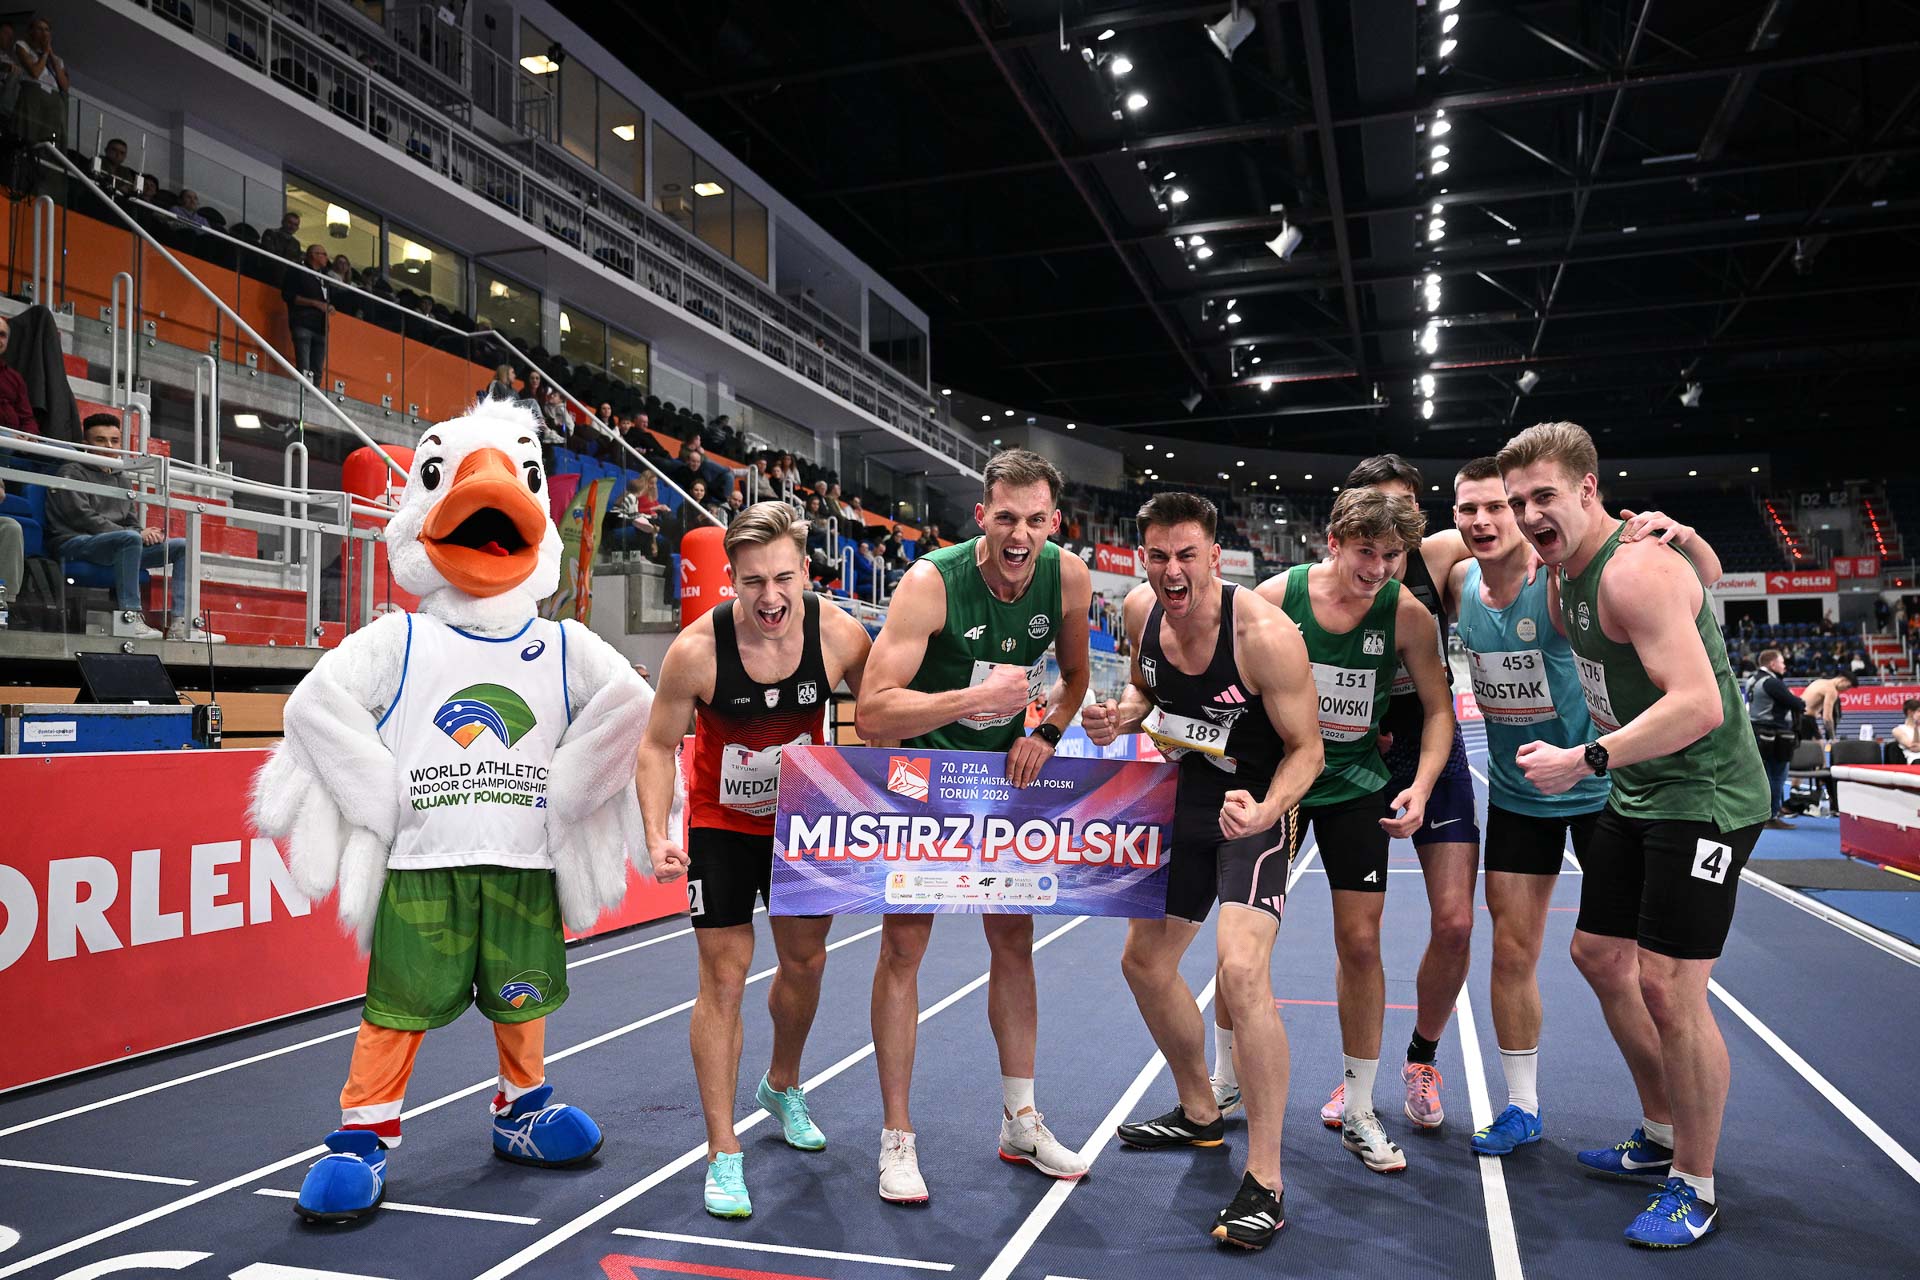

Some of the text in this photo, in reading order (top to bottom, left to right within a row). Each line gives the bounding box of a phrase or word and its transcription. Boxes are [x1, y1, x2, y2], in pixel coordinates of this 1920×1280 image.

[1110, 553, 1132, 567] ORLEN
[1716, 577, 1757, 589] polanik
[1792, 576, 1831, 587] ORLEN
[964, 624, 987, 640] 4F
[1502, 654, 1535, 671] 453
[1335, 672, 1367, 688] 151
[1581, 662, 1600, 682] 176
[1474, 678, 1545, 700] SZOSTAK
[1185, 723, 1220, 743] 189
[1325, 730, 1345, 739] 2026
[410, 761, 549, 782] WORLD ATHLETIC
[941, 762, 989, 775] 70. PZLA
[410, 780, 459, 796] INDOOR
[940, 775, 979, 785] HALOWE
[1043, 780, 1074, 789] POLSKI
[411, 793, 471, 811] KUJAWY
[474, 791, 534, 807] POMORZE
[940, 786, 1010, 801] TORUŃ 2026
[786, 814, 1162, 866] MISTRZ POLSKI
[1700, 846, 1723, 879] 4
[979, 877, 997, 887] 4F
[688, 884, 698, 913] 2
